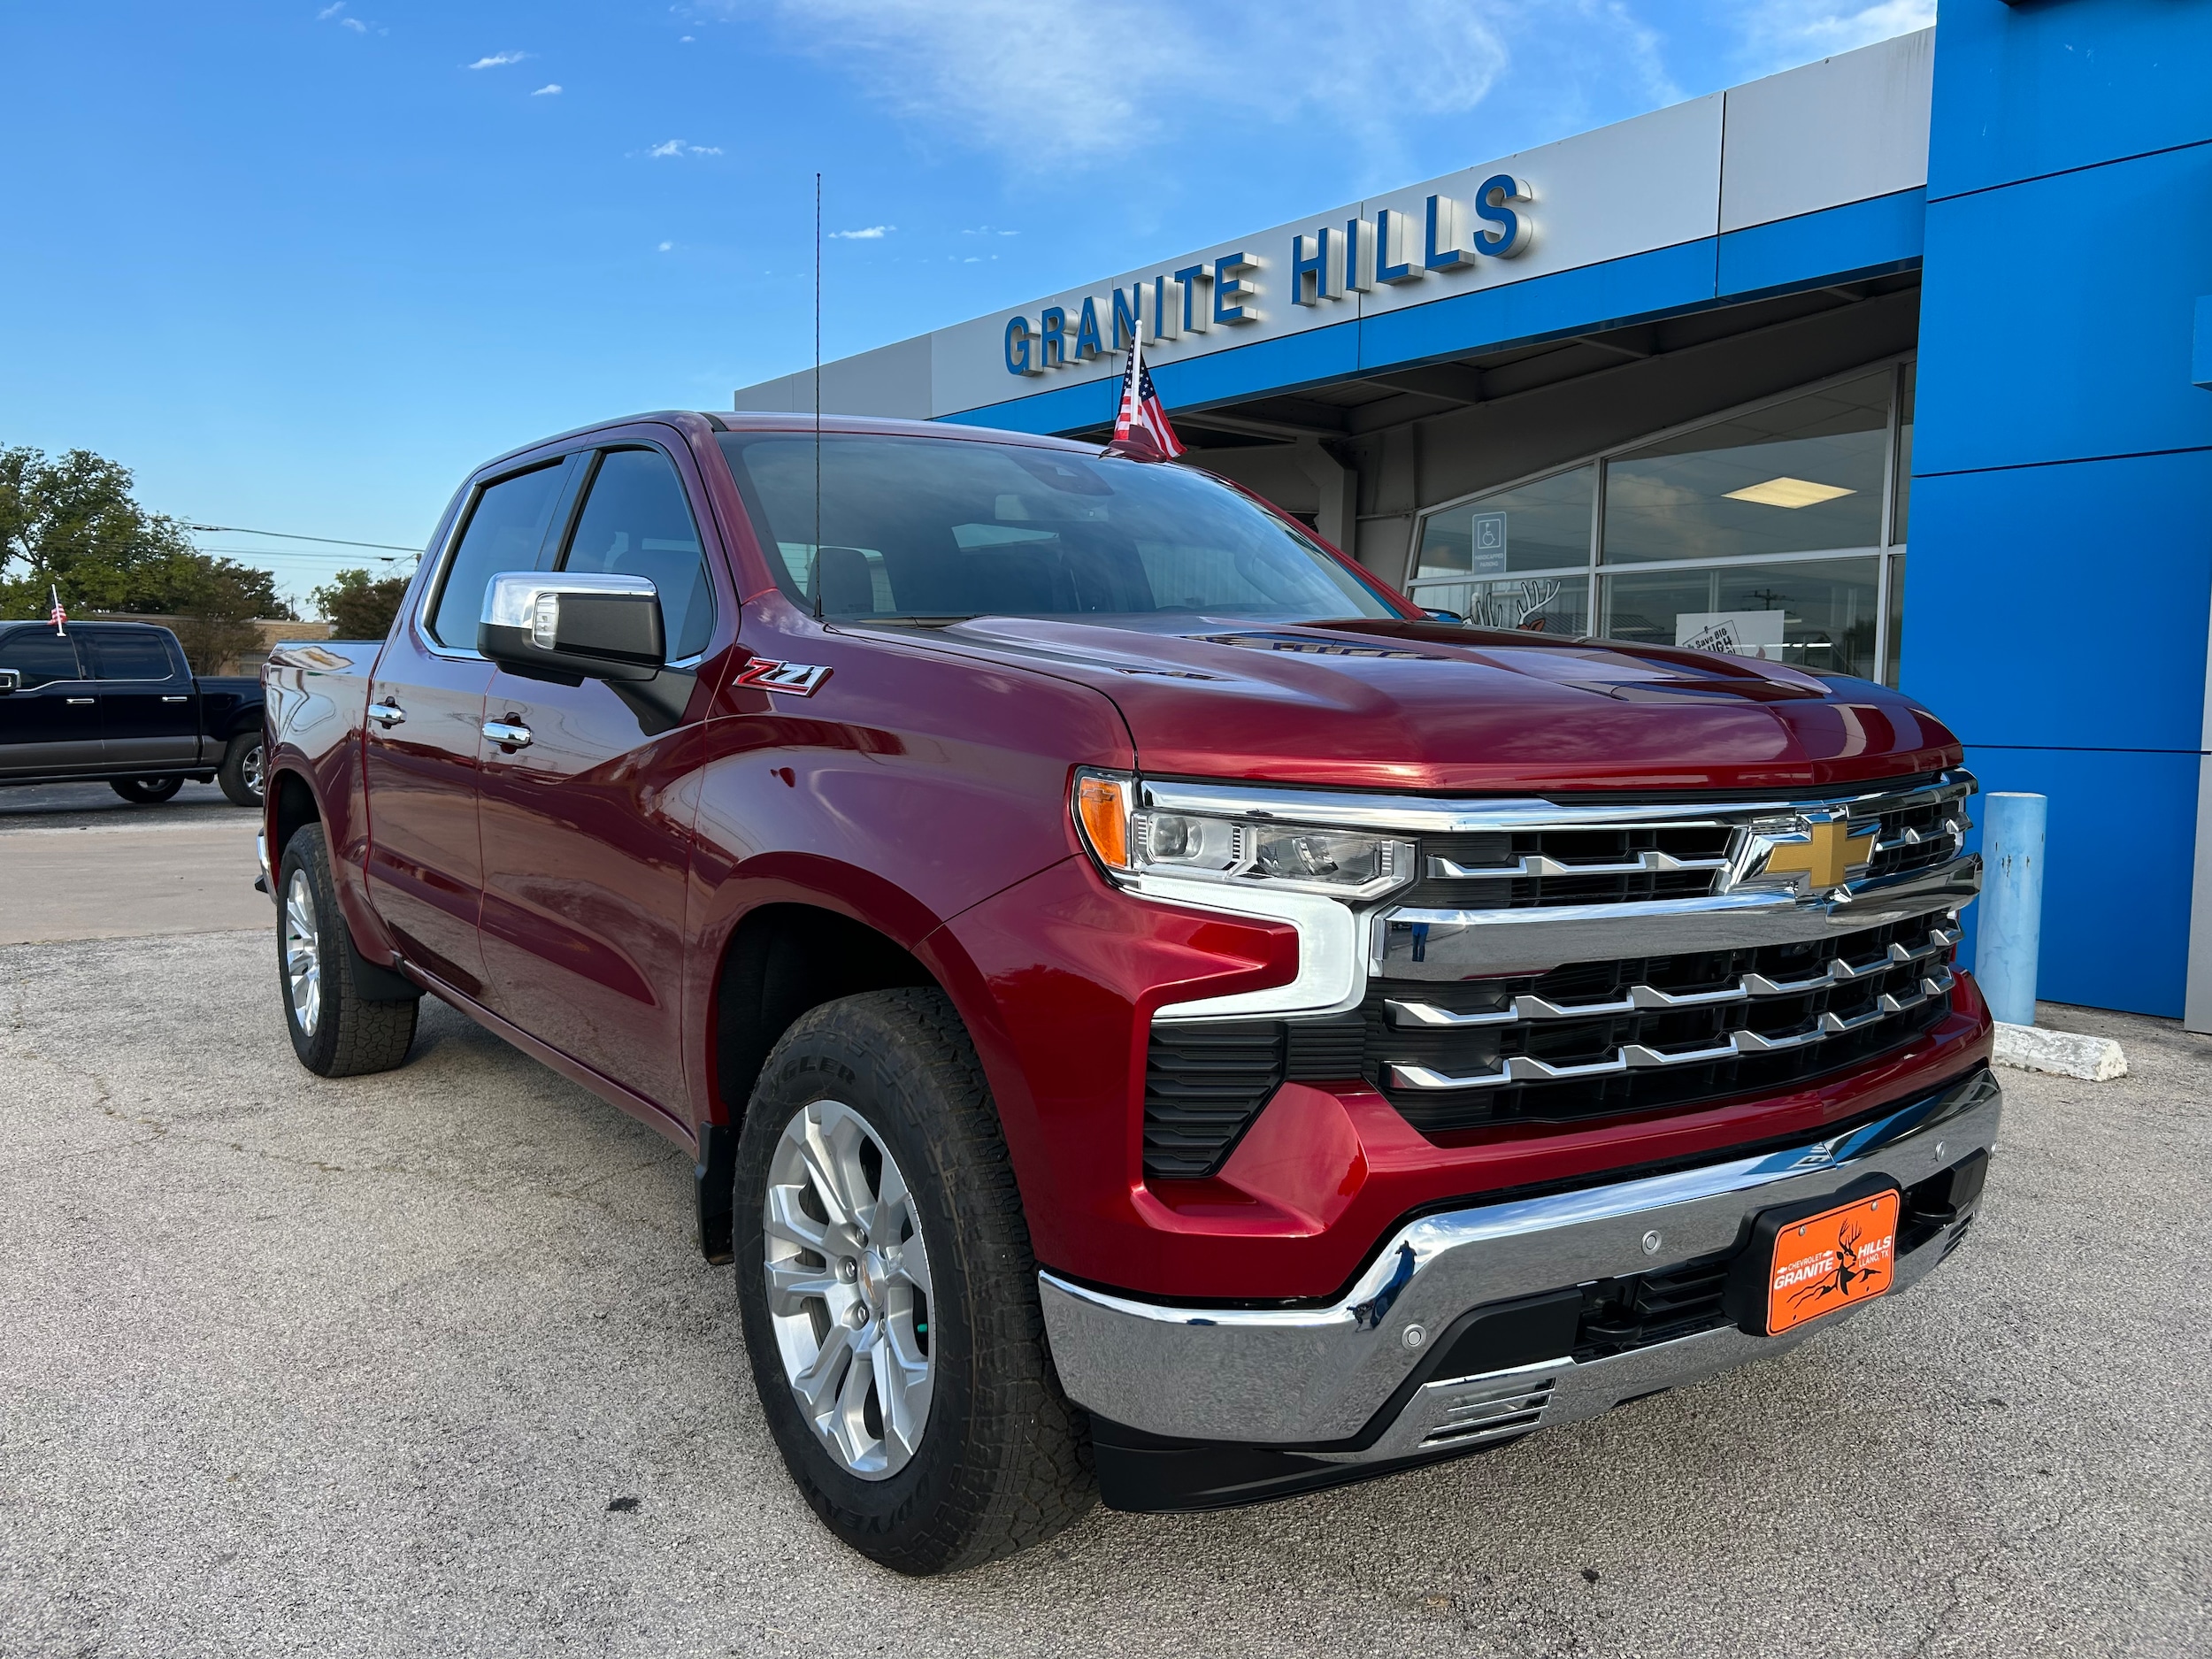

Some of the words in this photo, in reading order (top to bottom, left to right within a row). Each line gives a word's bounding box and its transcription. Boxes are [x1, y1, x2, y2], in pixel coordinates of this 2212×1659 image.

[1004, 252, 1256, 376] GRANITE
[1292, 173, 1532, 306] HILLS
[1695, 635, 1714, 649] Save
[1714, 627, 1727, 640] BIG
[732, 656, 834, 698] Z71
[1774, 1257, 1833, 1290] GRANITE
[1858, 1235, 1892, 1258] HILLS
[1787, 1252, 1823, 1271] CHEVROLET
[1859, 1253, 1879, 1268] LLANO,
[1881, 1249, 1889, 1259] TX
